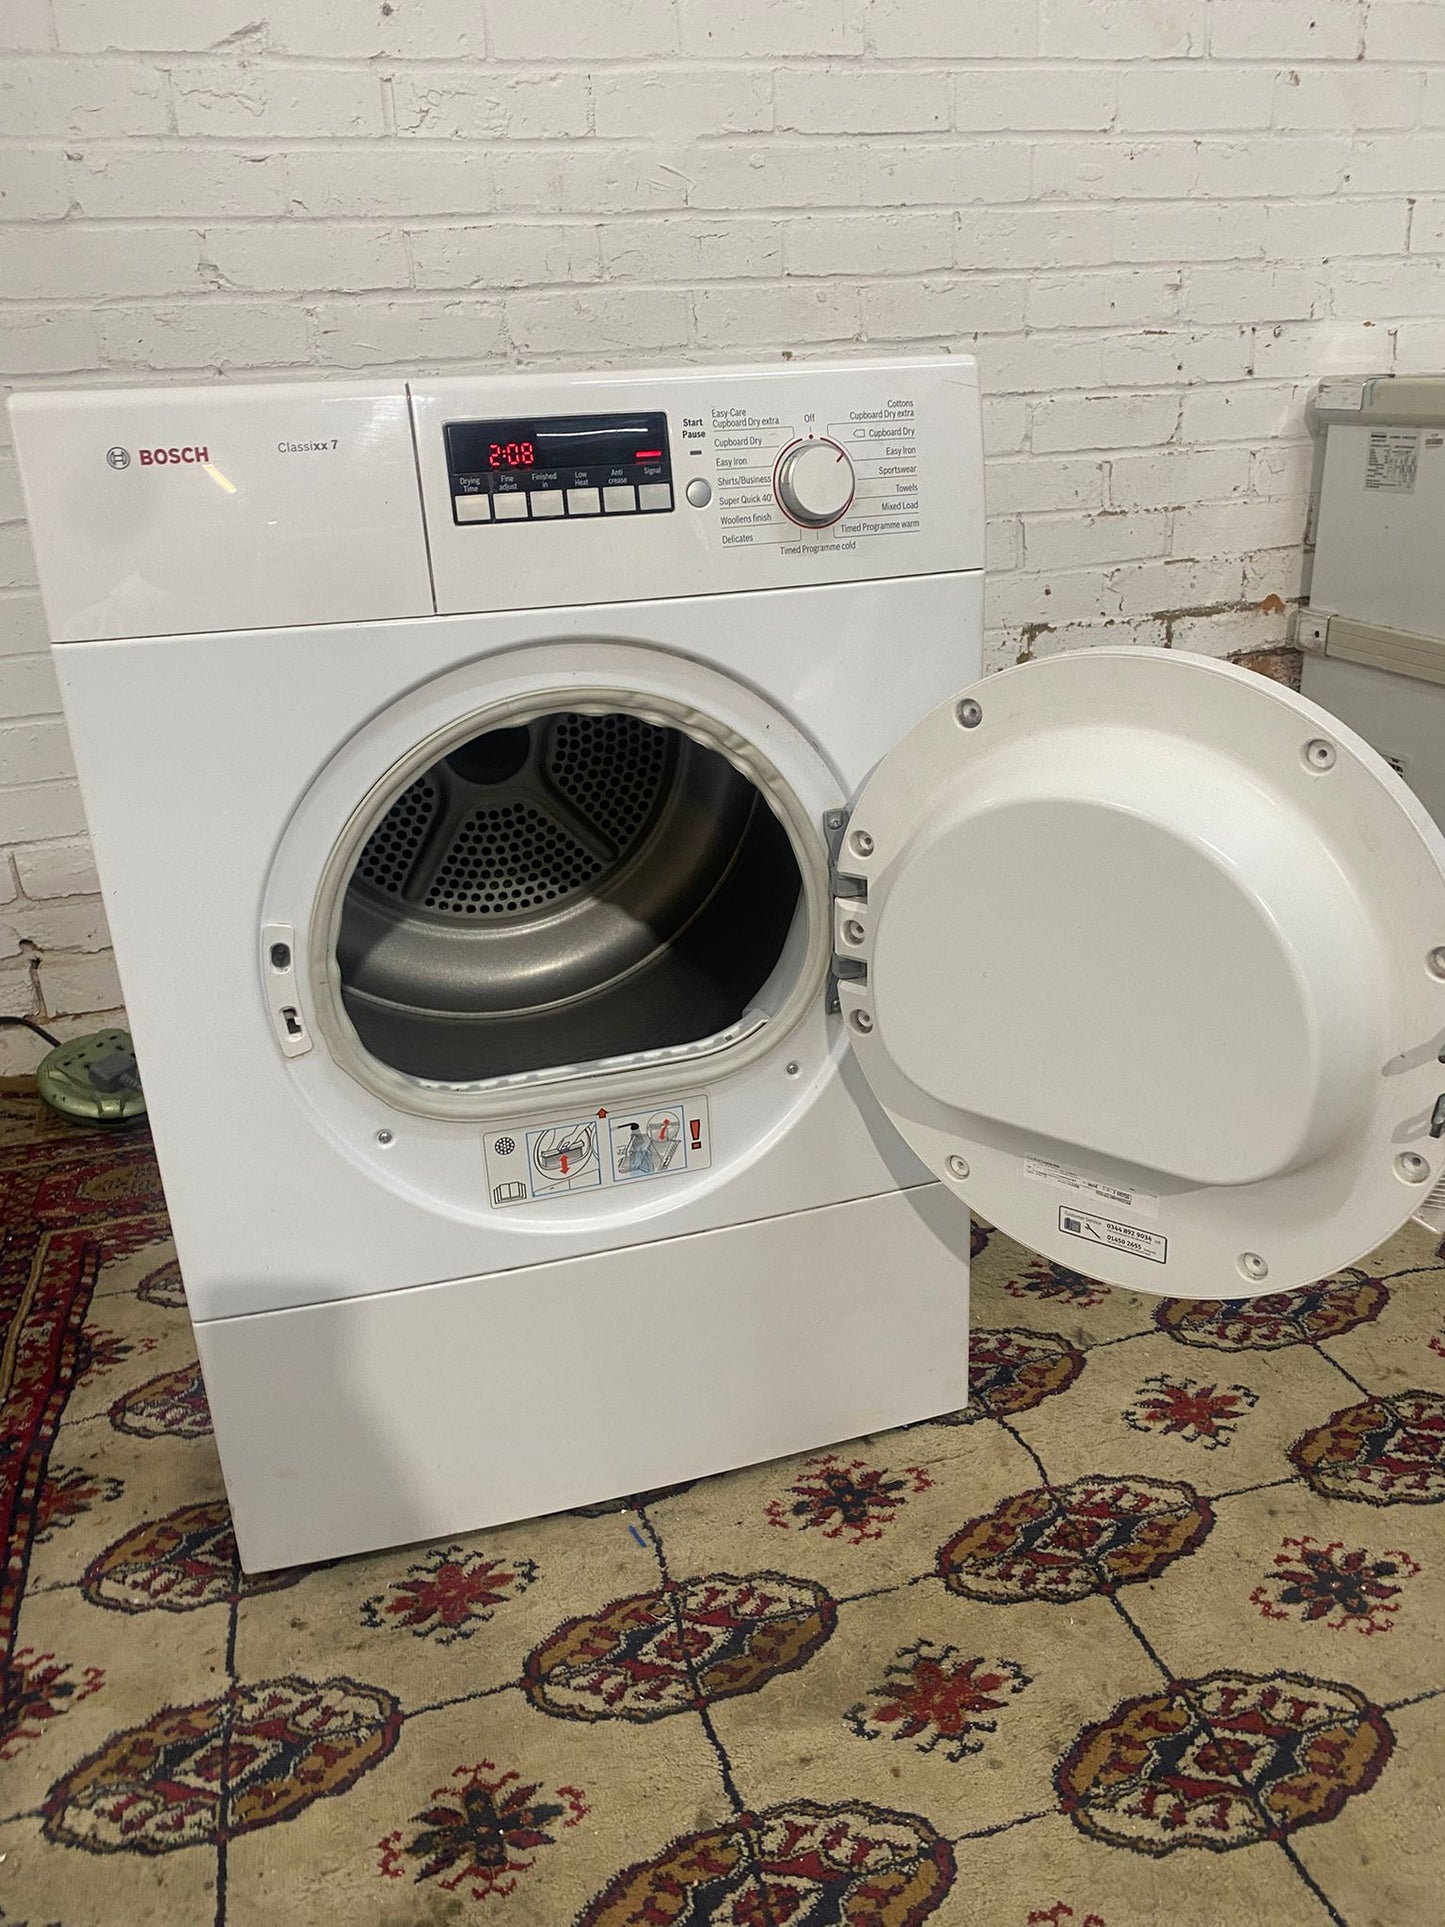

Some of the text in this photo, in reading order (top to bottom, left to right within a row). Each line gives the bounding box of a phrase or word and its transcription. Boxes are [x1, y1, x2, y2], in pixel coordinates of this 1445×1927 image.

[887, 399, 914, 408] Cottons
[804, 414, 815, 423] Off
[850, 409, 914, 420] Cupboard Dry extra
[683, 418, 703, 427] Start
[712, 416, 780, 428] Cupboard Dry extra
[682, 430, 706, 438] Pause
[868, 428, 915, 439] Cupboard Dry
[278, 439, 338, 453] Classixx 7
[714, 436, 762, 447] Cupboard Dry
[139, 447, 209, 465] BOSCH
[490, 442, 534, 467] 2:08
[886, 445, 916, 457] Easy Iron
[716, 456, 748, 467] Easy Iron
[574, 471, 587, 479] Low
[610, 468, 623, 477] Anti
[643, 467, 661, 476] Signal
[879, 466, 917, 476] Sportswear
[460, 477, 480, 486] Drying
[500, 475, 514, 483] Fine
[531, 472, 557, 481] Finished
[608, 477, 628, 485] crease
[717, 475, 772, 487] Shirts/Business
[499, 482, 518, 492] adjust
[574, 479, 589, 487] Heat
[463, 485, 479, 493] Time
[896, 484, 918, 493] Towels
[719, 497, 740, 507] Super
[741, 495, 761, 505] Quick
[882, 500, 919, 511] Mixed Load
[720, 513, 772, 525] Woollens finish
[842, 520, 920, 533] Timed Programme warm
[722, 534, 754, 544] Delicates
[781, 541, 856, 555] Timed Programme cold
[1106, 1223, 1122, 1233] 0344
[1123, 1228, 1135, 1236] 892
[1136, 1232, 1152, 1242] 9034
[1106, 1234, 1126, 1245] 01450
[1127, 1240, 1142, 1251] 2655
